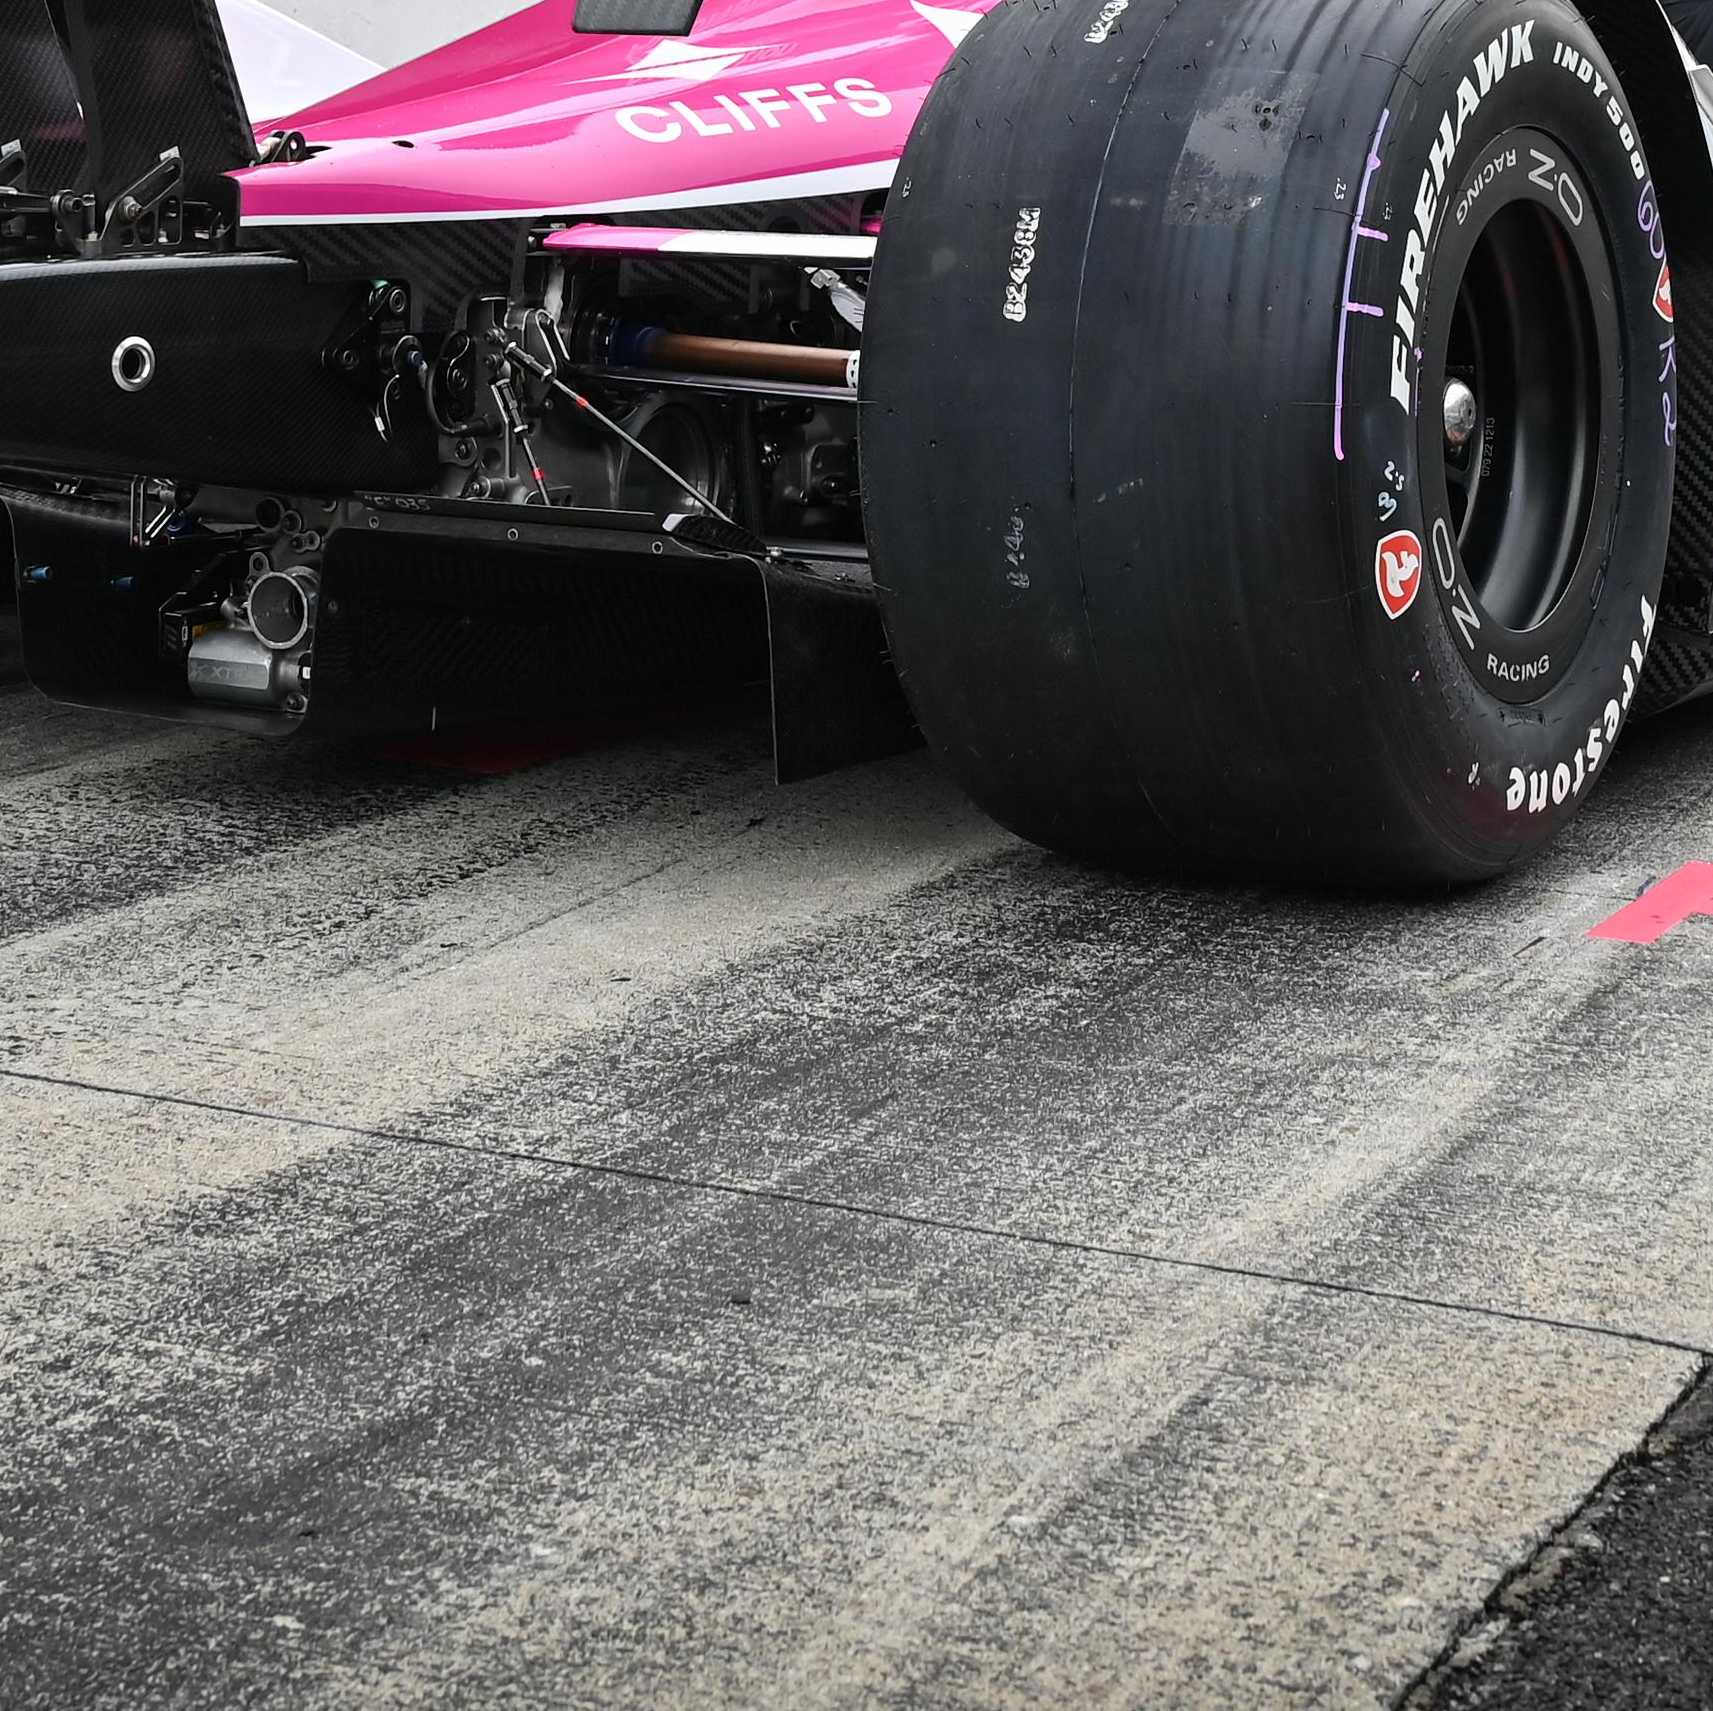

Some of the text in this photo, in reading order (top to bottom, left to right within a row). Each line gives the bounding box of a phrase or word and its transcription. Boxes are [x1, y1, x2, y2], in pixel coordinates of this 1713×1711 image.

[614, 75, 893, 144] CLIFFS
[1553, 40, 1647, 182] INDY 500
[1389, 19, 1536, 417] FIREHAWK
[1455, 147, 1517, 226] RACING
[1486, 652, 1551, 683] RACING
[1506, 593, 1657, 814] Firestone
